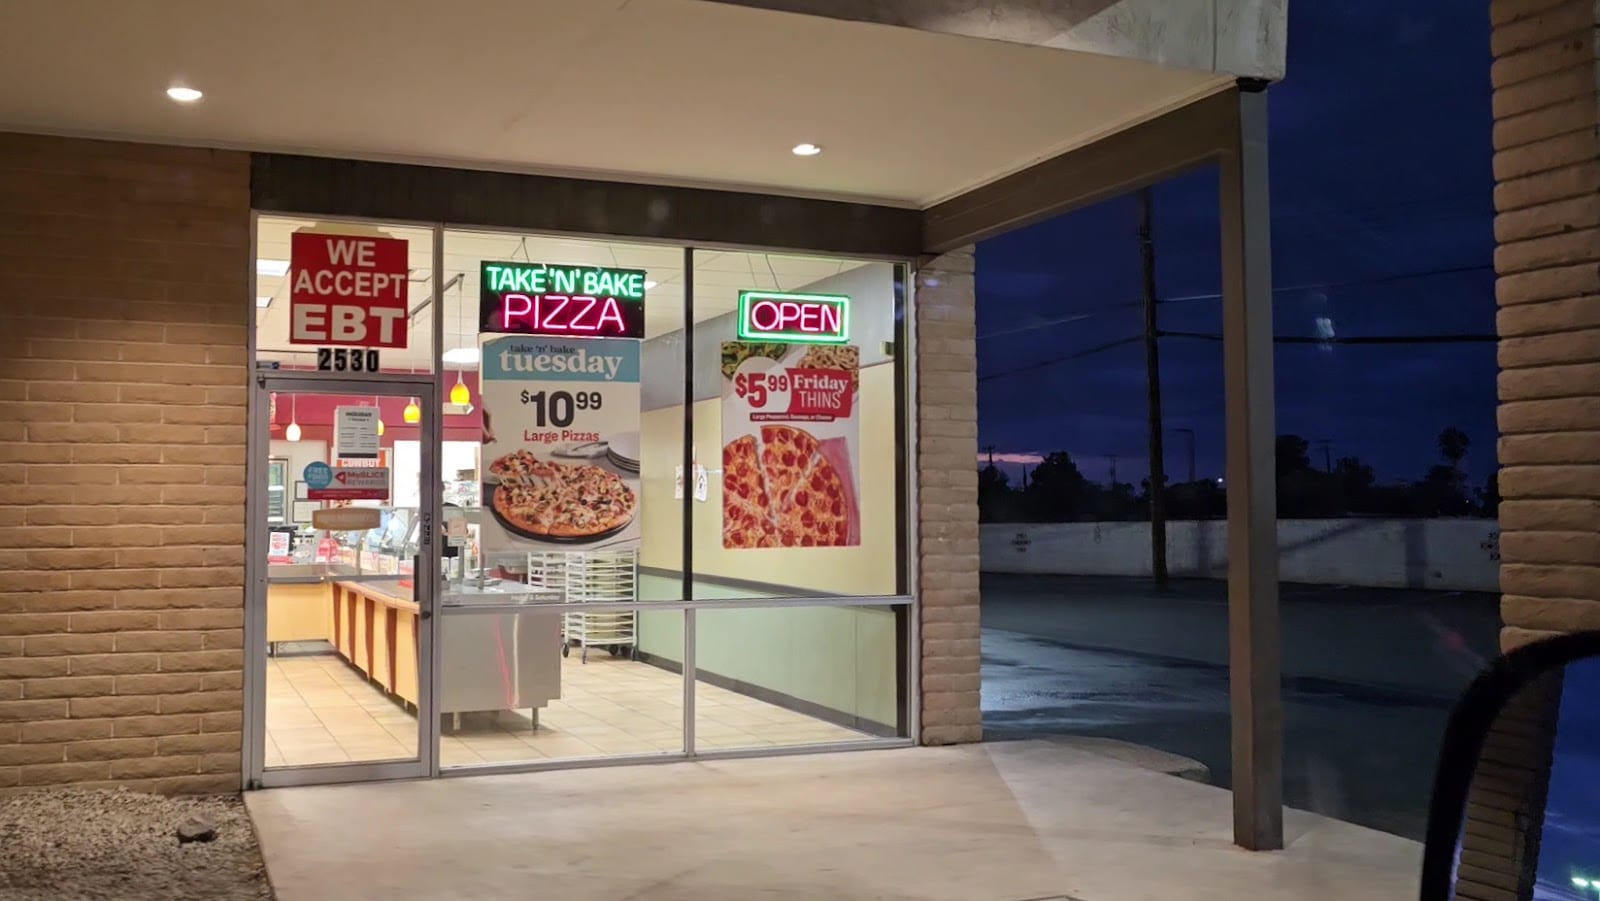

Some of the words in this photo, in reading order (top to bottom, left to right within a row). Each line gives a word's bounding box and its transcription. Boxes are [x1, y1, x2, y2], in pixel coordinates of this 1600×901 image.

[326, 239, 376, 267] WE
[293, 269, 405, 298] ACCEPT
[486, 266, 547, 292] TAKE
[550, 268, 581, 293] 'N'
[583, 271, 643, 297] BAKE
[293, 303, 405, 343] EBT
[504, 294, 625, 331] PIZZA
[752, 301, 840, 332] OPEN
[318, 348, 379, 372] 2530
[510, 344, 533, 353] take
[550, 345, 576, 354] bake
[500, 349, 623, 379] tuesday
[793, 374, 848, 393] Friday
[799, 390, 840, 409] THINS
[524, 430, 558, 444] Large
[562, 430, 600, 442] Pizzas
